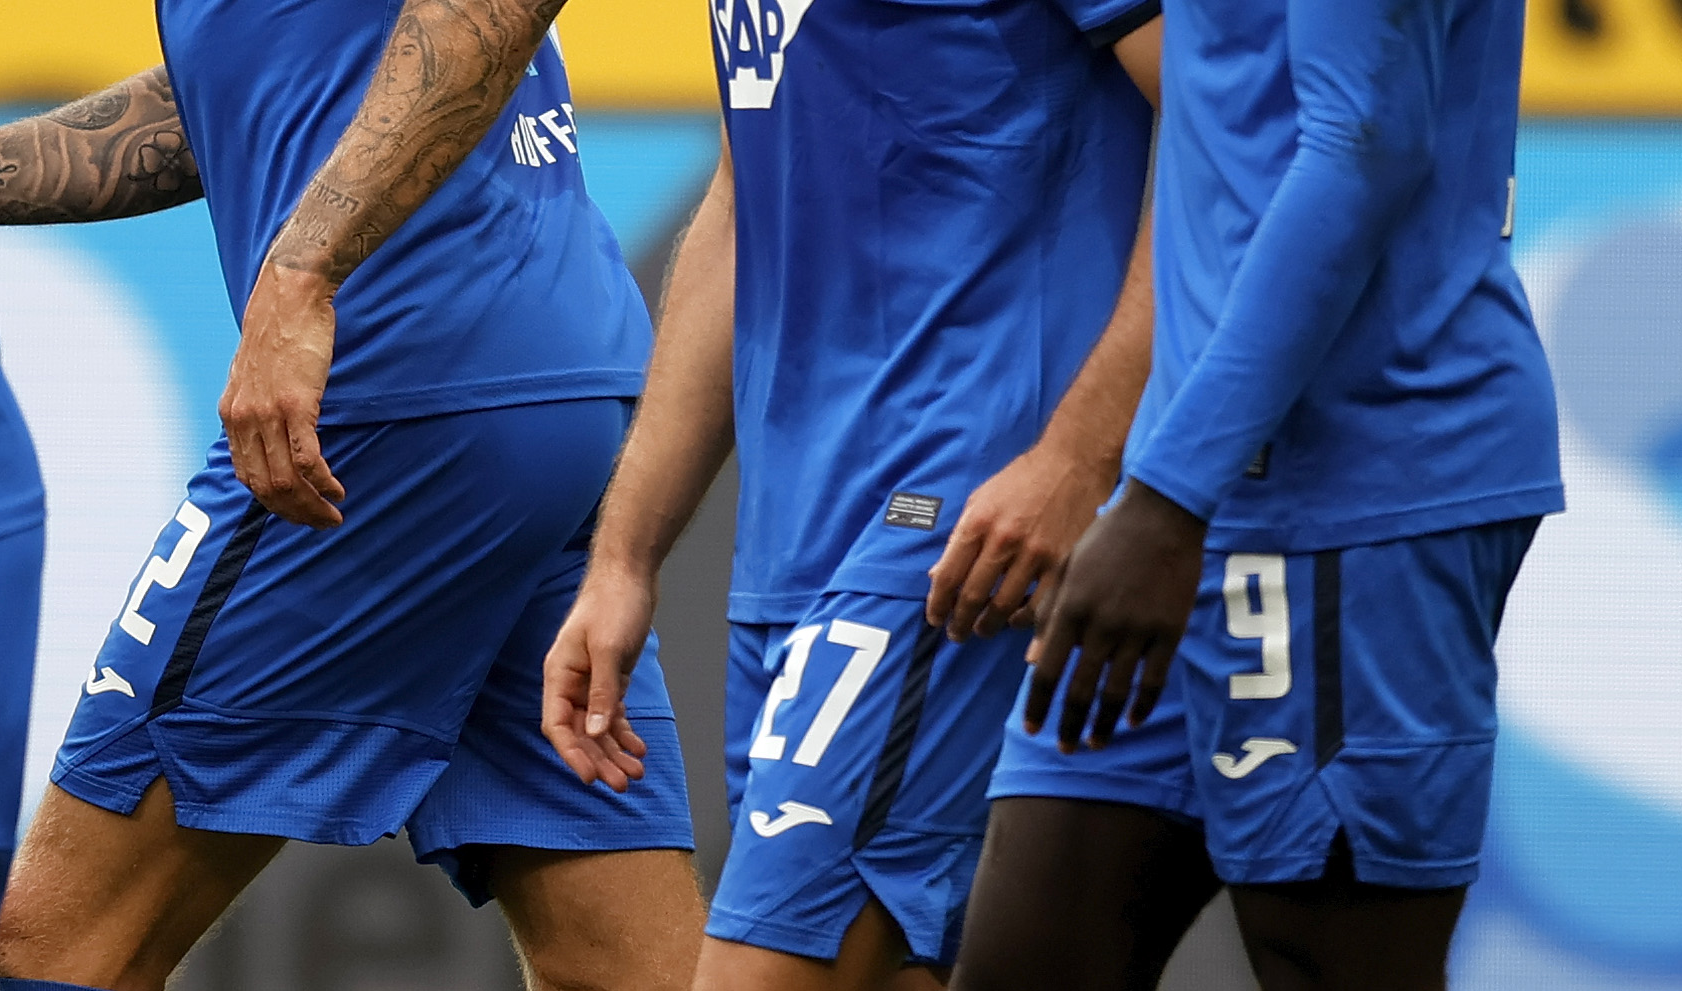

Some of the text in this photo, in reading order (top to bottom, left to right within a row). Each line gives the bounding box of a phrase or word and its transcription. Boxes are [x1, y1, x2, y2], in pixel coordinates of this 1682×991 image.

[119, 500, 211, 646] 2
[1222, 552, 1293, 700] 9
[748, 618, 892, 768] 27
